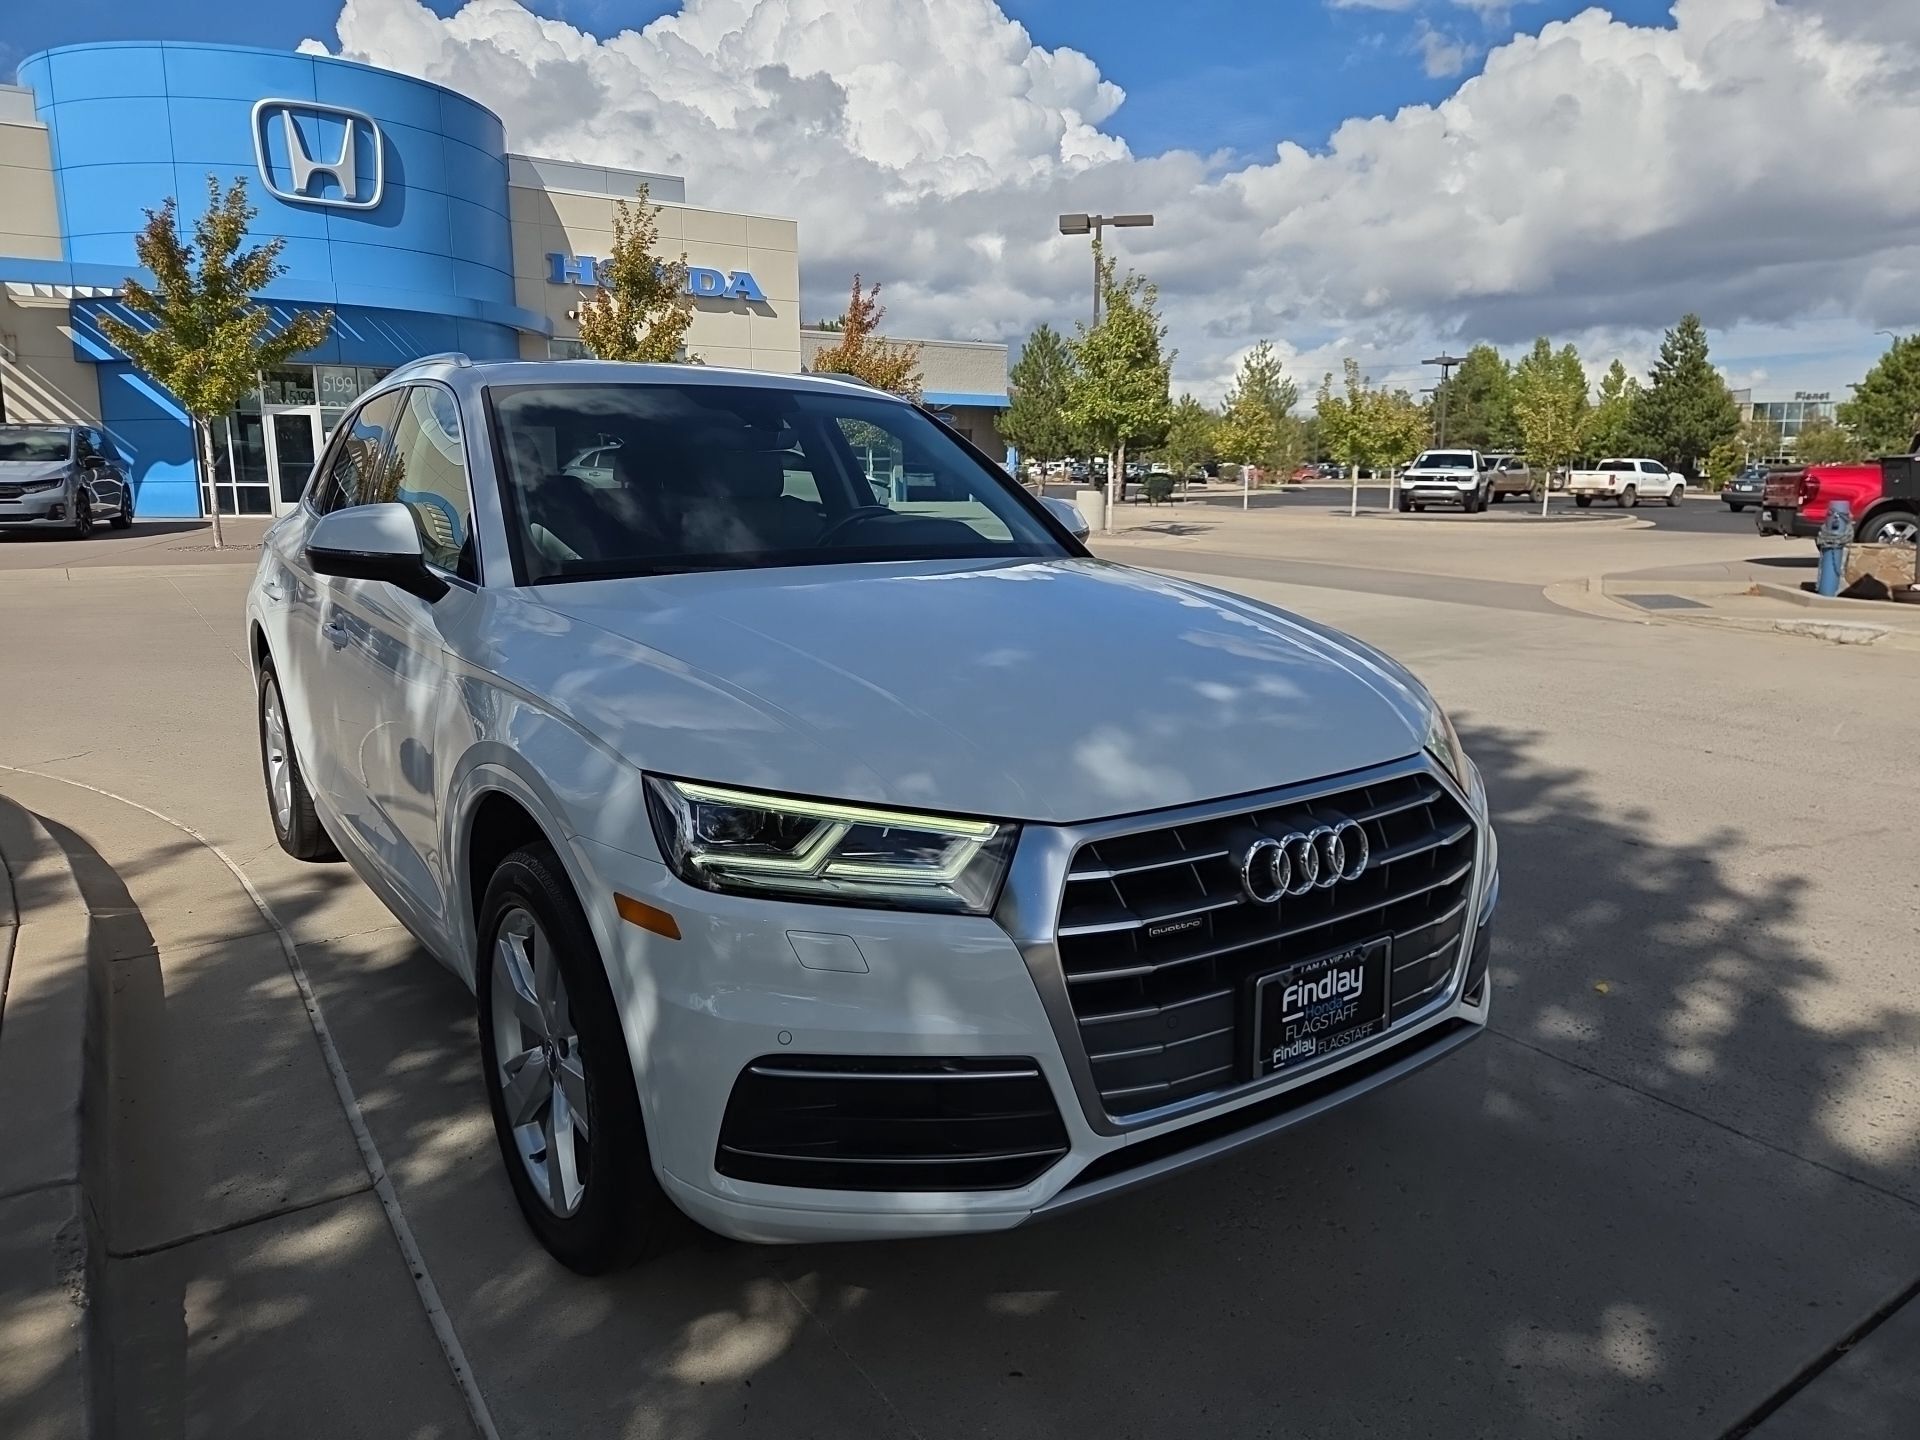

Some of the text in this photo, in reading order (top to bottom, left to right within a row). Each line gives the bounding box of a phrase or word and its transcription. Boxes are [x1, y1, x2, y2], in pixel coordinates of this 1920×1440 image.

[545, 252, 768, 301] HDA
[322, 375, 353, 393] 5199
[1152, 920, 1200, 935] quattro
[1282, 965, 1364, 1013] Findlay
[1305, 998, 1344, 1019] Honda
[1285, 1002, 1359, 1042] FLAGSTAFF
[1273, 1037, 1317, 1064] Findlay
[1317, 1023, 1374, 1054] FLAGSTAFF
